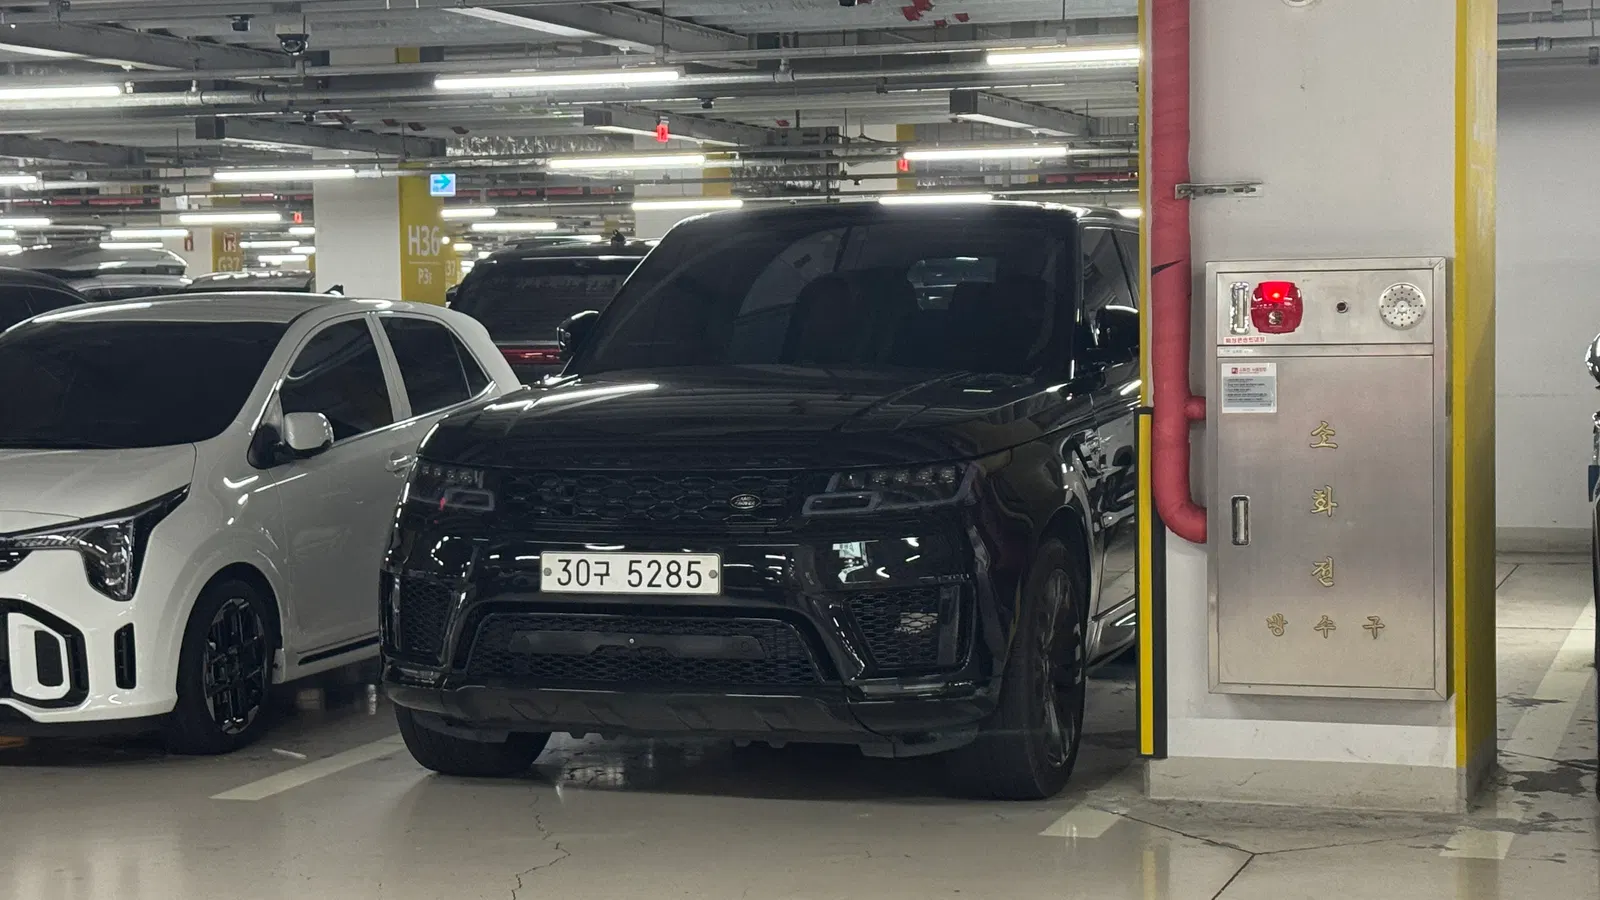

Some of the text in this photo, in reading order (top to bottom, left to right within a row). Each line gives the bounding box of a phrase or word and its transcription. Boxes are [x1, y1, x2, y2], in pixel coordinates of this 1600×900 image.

[408, 225, 440, 256] H36
[1310, 420, 1338, 587] 소화전
[557, 559, 702, 589] 30구 5285
